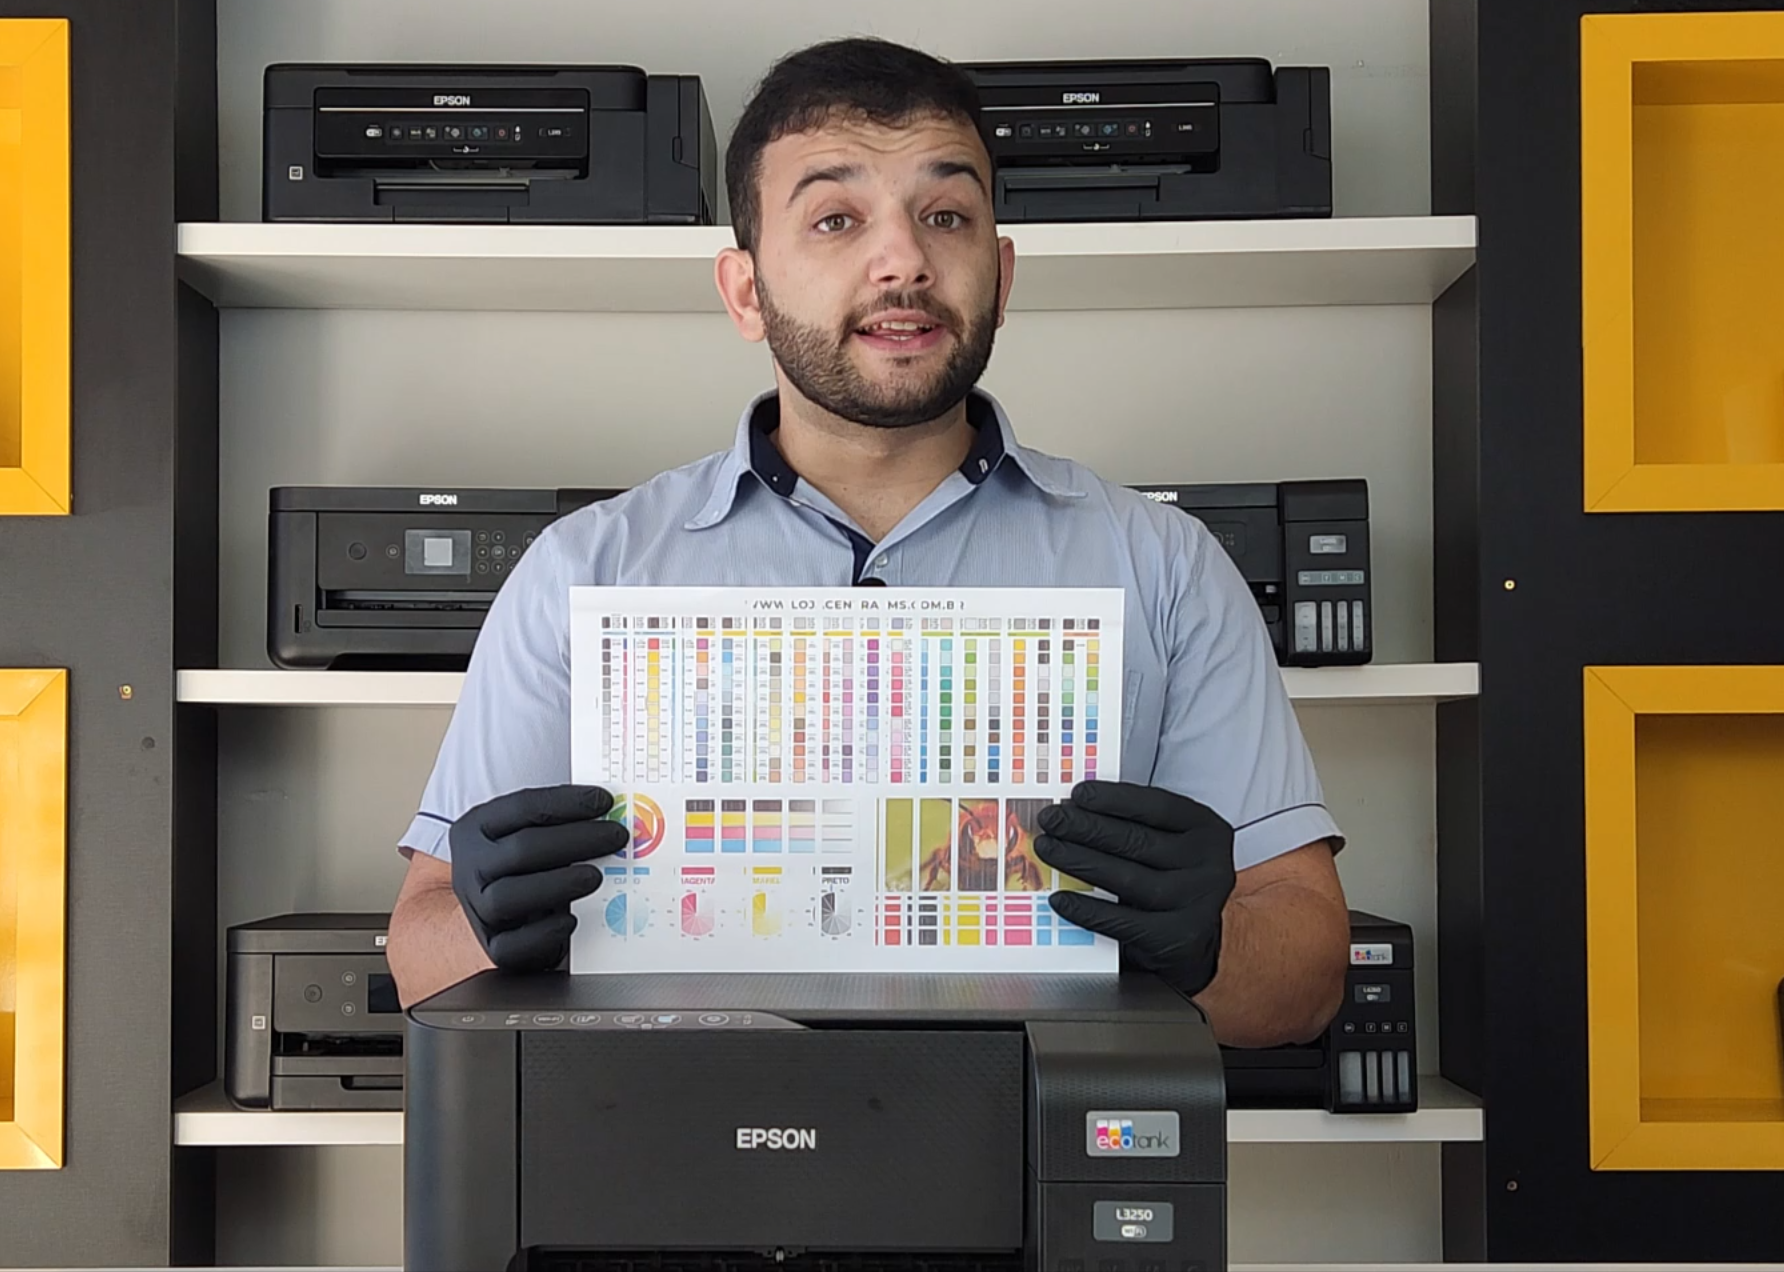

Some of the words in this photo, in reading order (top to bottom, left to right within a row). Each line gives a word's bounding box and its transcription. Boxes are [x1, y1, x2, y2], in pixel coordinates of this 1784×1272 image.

[433, 95, 470, 106] EPSON
[1062, 93, 1099, 104] EPSON
[419, 494, 457, 506] EPSON
[1140, 491, 1178, 502] PSON
[736, 1127, 816, 1150] EPSON
[1096, 1128, 1170, 1150] ecotank
[1115, 1208, 1153, 1221] L3250
